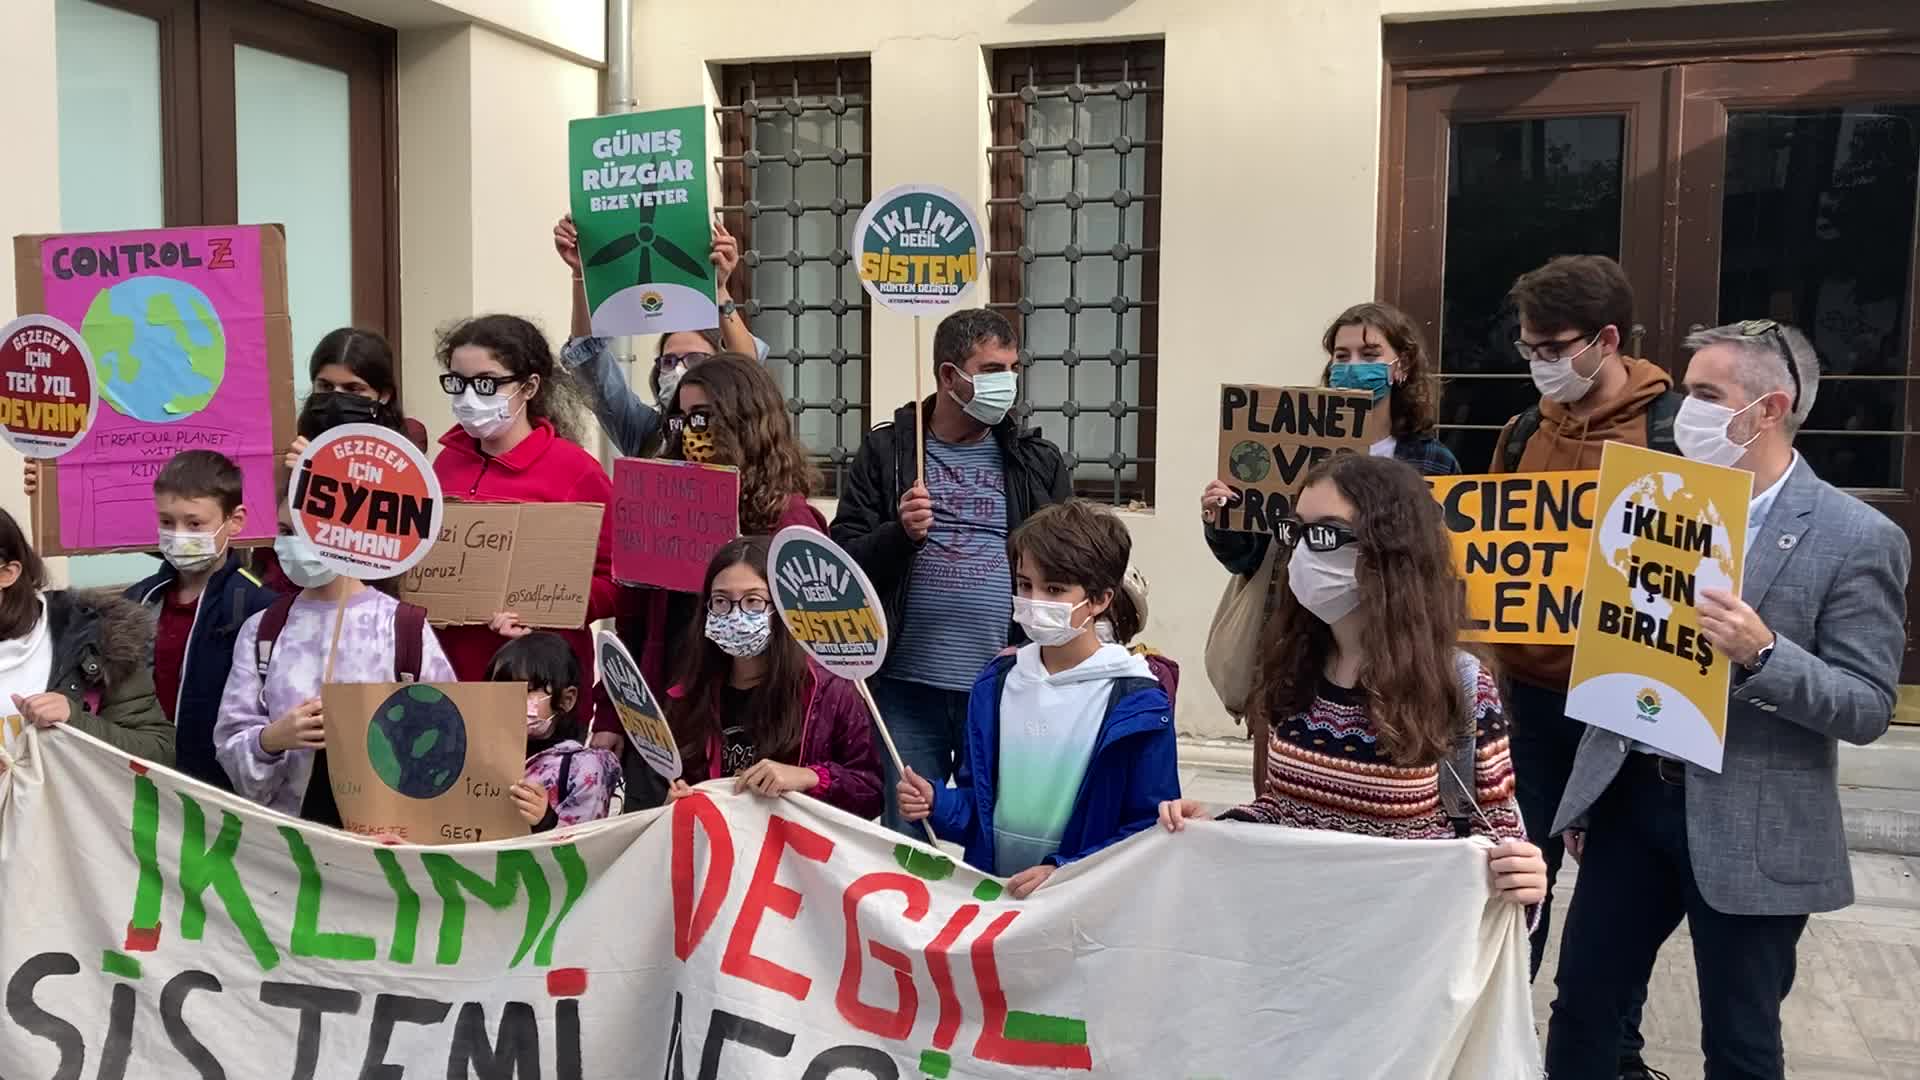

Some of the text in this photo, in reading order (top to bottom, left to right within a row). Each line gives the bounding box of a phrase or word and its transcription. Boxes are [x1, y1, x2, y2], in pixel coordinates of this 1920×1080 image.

[591, 128, 682, 157] GÜNEŞ
[582, 159, 695, 191] RÜZGAR
[590, 188, 689, 212] BİZE YETER
[870, 200, 969, 243] İKLİMİ
[52, 237, 235, 280] CONTROL Z
[863, 246, 978, 285] SİSTEMİ
[12, 329, 70, 355] GEZEGEN
[25, 347, 52, 371] İÇİN
[5, 371, 76, 397] TEK YOL
[0, 396, 88, 433] DEVRİM
[1223, 387, 1372, 438] PLANET
[175, 431, 229, 445] PLANET
[332, 440, 409, 473] GEZEGEN
[347, 458, 384, 485] İÇİN
[292, 459, 434, 539] İSYAN
[314, 521, 402, 560] ZAMANI
[464, 520, 513, 552] Geri
[1621, 501, 1713, 558] İKLİM
[776, 548, 851, 598] İKLİMİ
[1466, 541, 1569, 577] NOT
[1628, 556, 1696, 607] İÇİN
[784, 598, 884, 644] SİSTEMİ
[1598, 599, 1714, 676] BİRLEŞ
[466, 776, 501, 798] İÇİN
